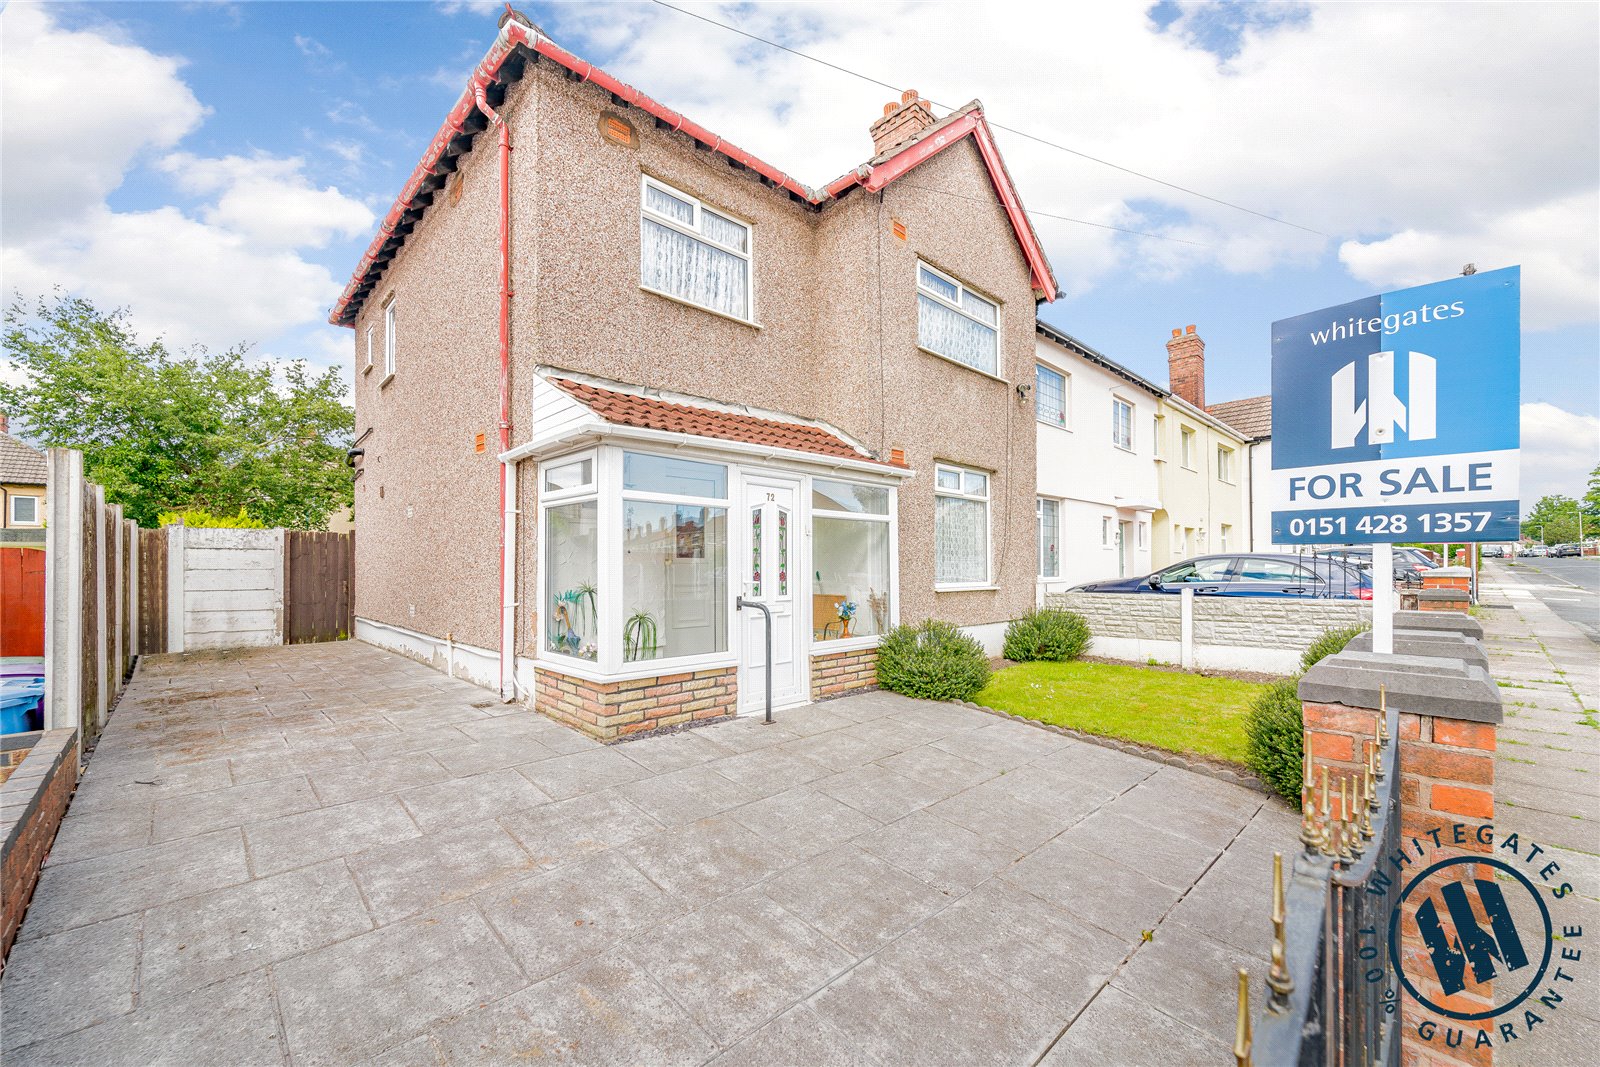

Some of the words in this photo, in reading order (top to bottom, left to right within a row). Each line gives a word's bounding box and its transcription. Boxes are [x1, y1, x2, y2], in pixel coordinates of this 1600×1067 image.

[1310, 300, 1465, 345] whitegates
[766, 492, 775, 502] 72
[1289, 472, 1363, 501] FOR
[1379, 462, 1493, 496] SALE
[1289, 516, 1347, 536] 0151
[1355, 514, 1408, 534] 428
[1417, 511, 1492, 533] 1357
